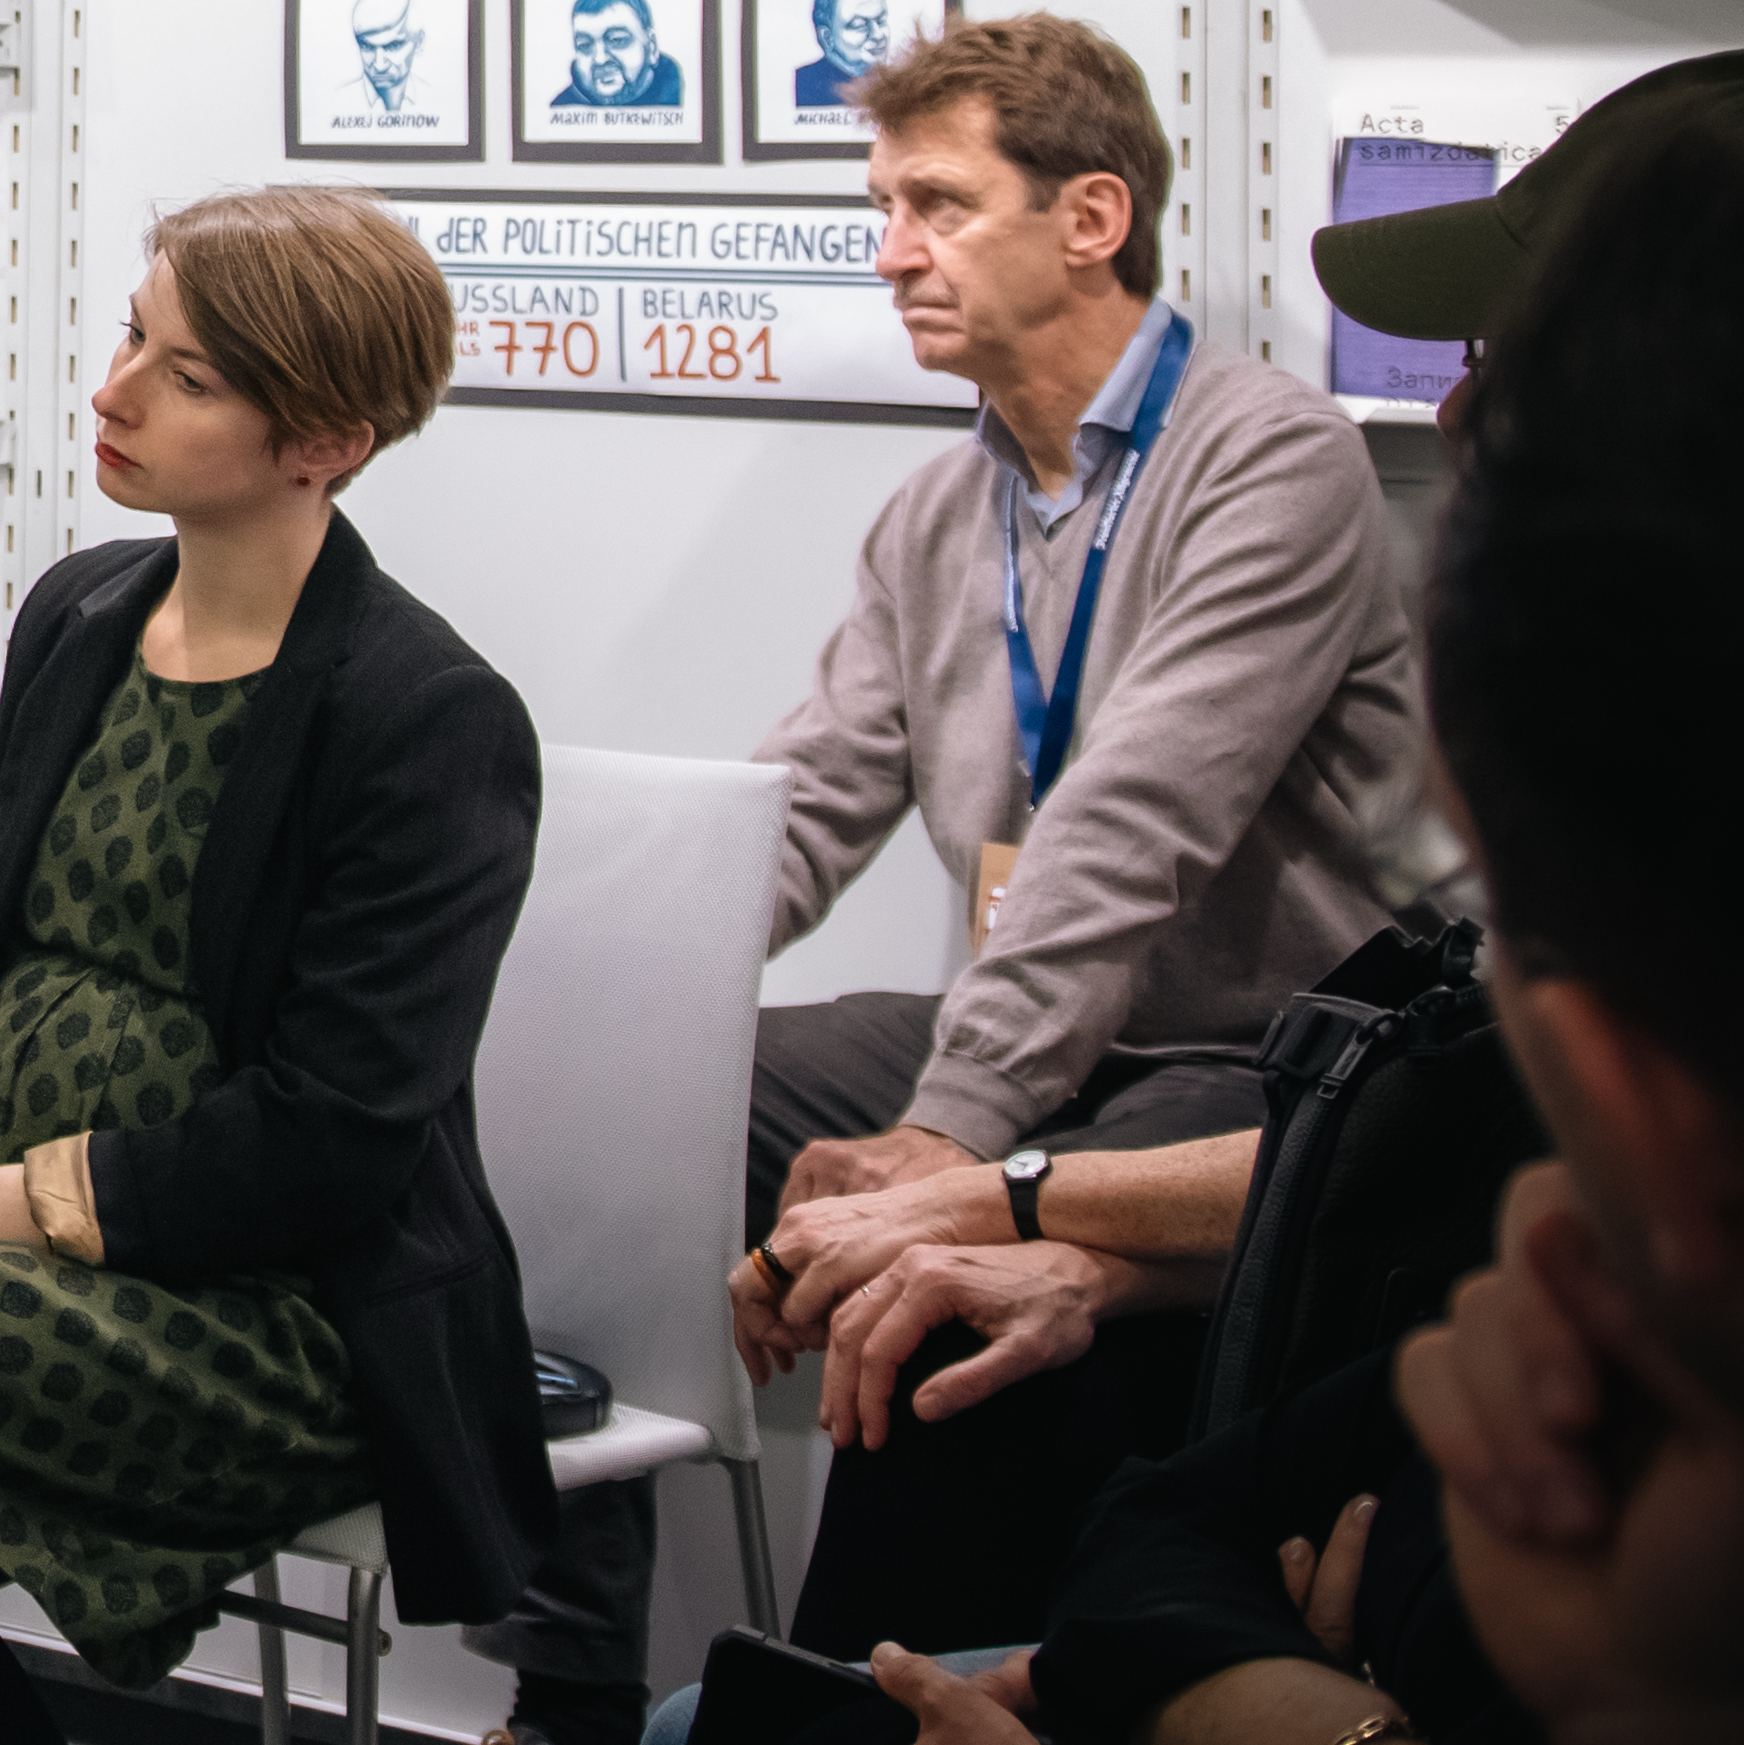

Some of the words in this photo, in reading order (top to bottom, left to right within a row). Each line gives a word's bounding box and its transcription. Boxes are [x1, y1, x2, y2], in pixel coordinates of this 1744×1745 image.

[1360, 114, 1424, 134] Acta
[710, 222, 886, 264] GEFANGEN
[454, 284, 600, 317] USSLAND
[642, 289, 779, 322] BELARUS
[488, 320, 600, 378] 770
[642, 323, 781, 384] 1281
